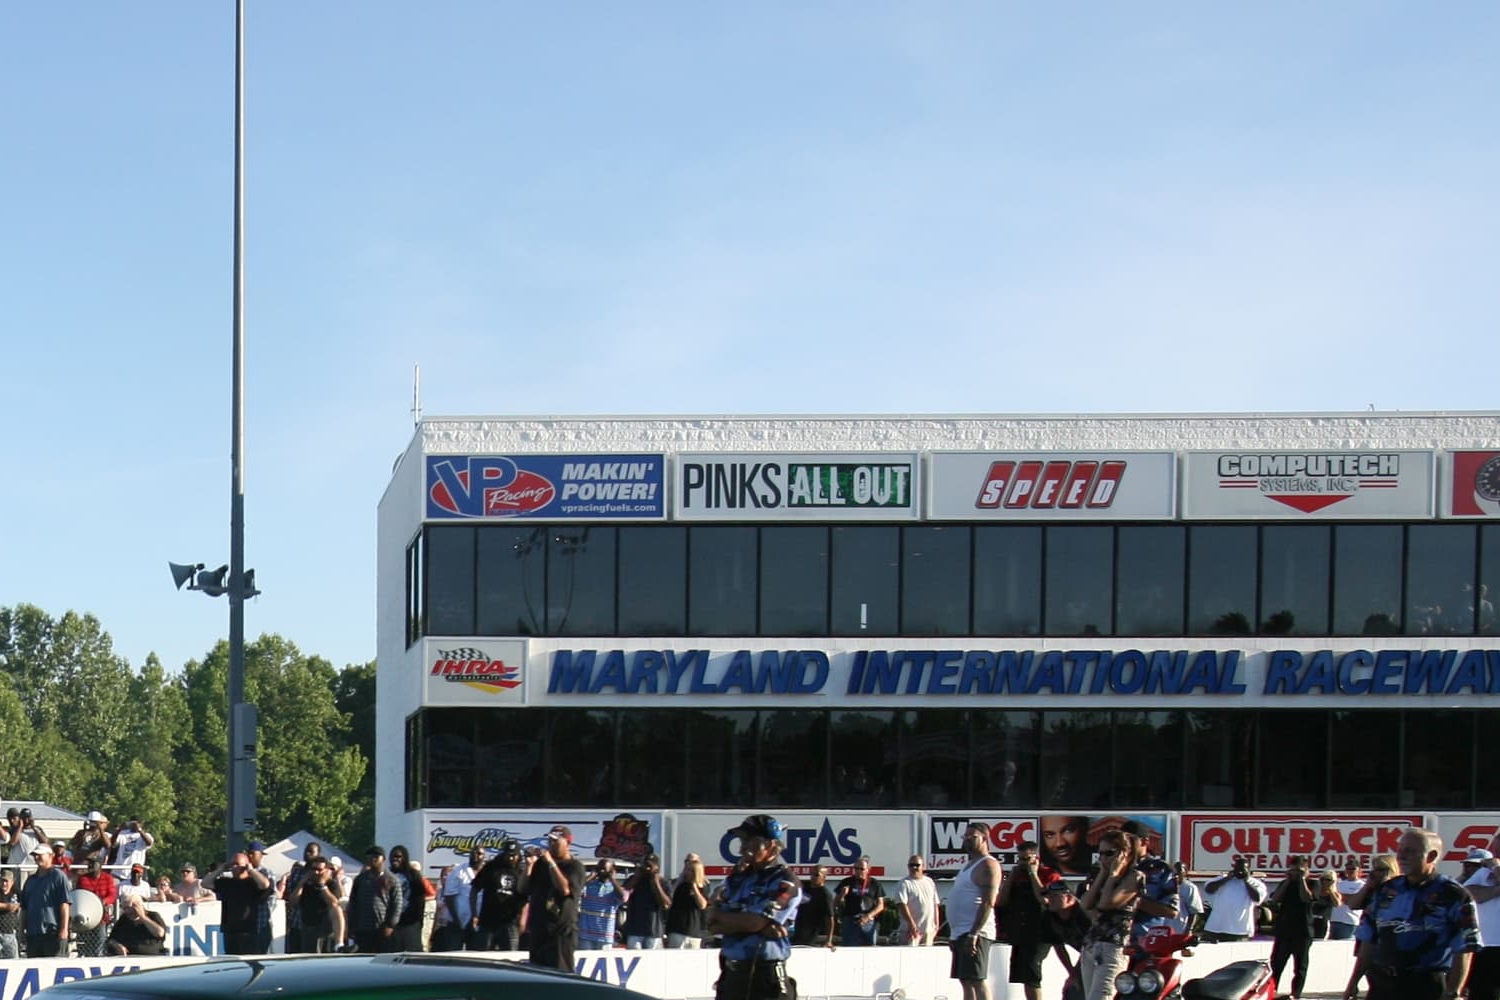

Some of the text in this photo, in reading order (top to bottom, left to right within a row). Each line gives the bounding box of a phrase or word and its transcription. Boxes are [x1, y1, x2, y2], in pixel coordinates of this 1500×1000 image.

[561, 462, 655, 480] MAKIN'
[1219, 454, 1400, 477] COMPUTECH
[432, 457, 518, 515] VP
[561, 483, 657, 500] POWER!
[683, 463, 910, 509] PINKS ALL OUT
[1259, 477, 1358, 493] SYSTEMS, INC.
[488, 486, 554, 510] Racing
[561, 503, 657, 514] vpracingfuels.com
[430, 659, 507, 676] IHRA
[547, 649, 830, 695] MARYLAND
[845, 649, 1246, 695] INTERNATIONAL
[1201, 827, 1403, 854] OUTBACK
